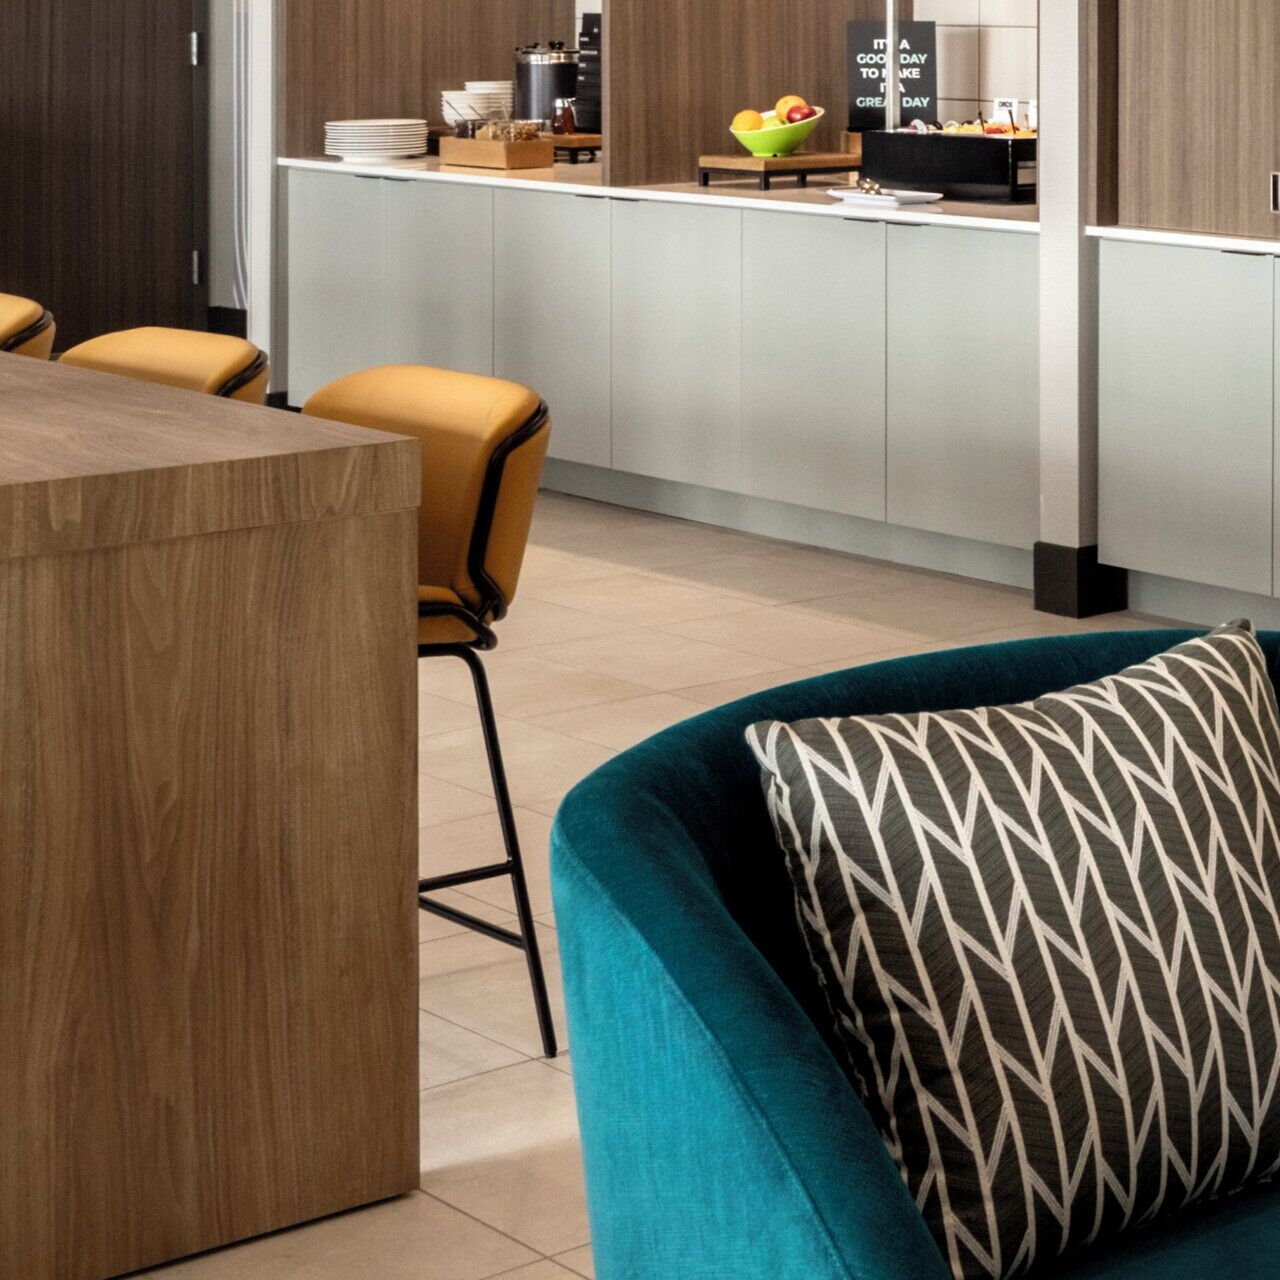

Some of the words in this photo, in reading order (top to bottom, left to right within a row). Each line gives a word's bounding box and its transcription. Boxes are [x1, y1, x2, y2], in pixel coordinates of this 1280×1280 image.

[900, 38, 910, 50] A
[856, 54, 889, 64] GOO
[900, 54, 928, 64] DAY
[860, 68, 879, 78] TO
[902, 97, 930, 108] DAY
